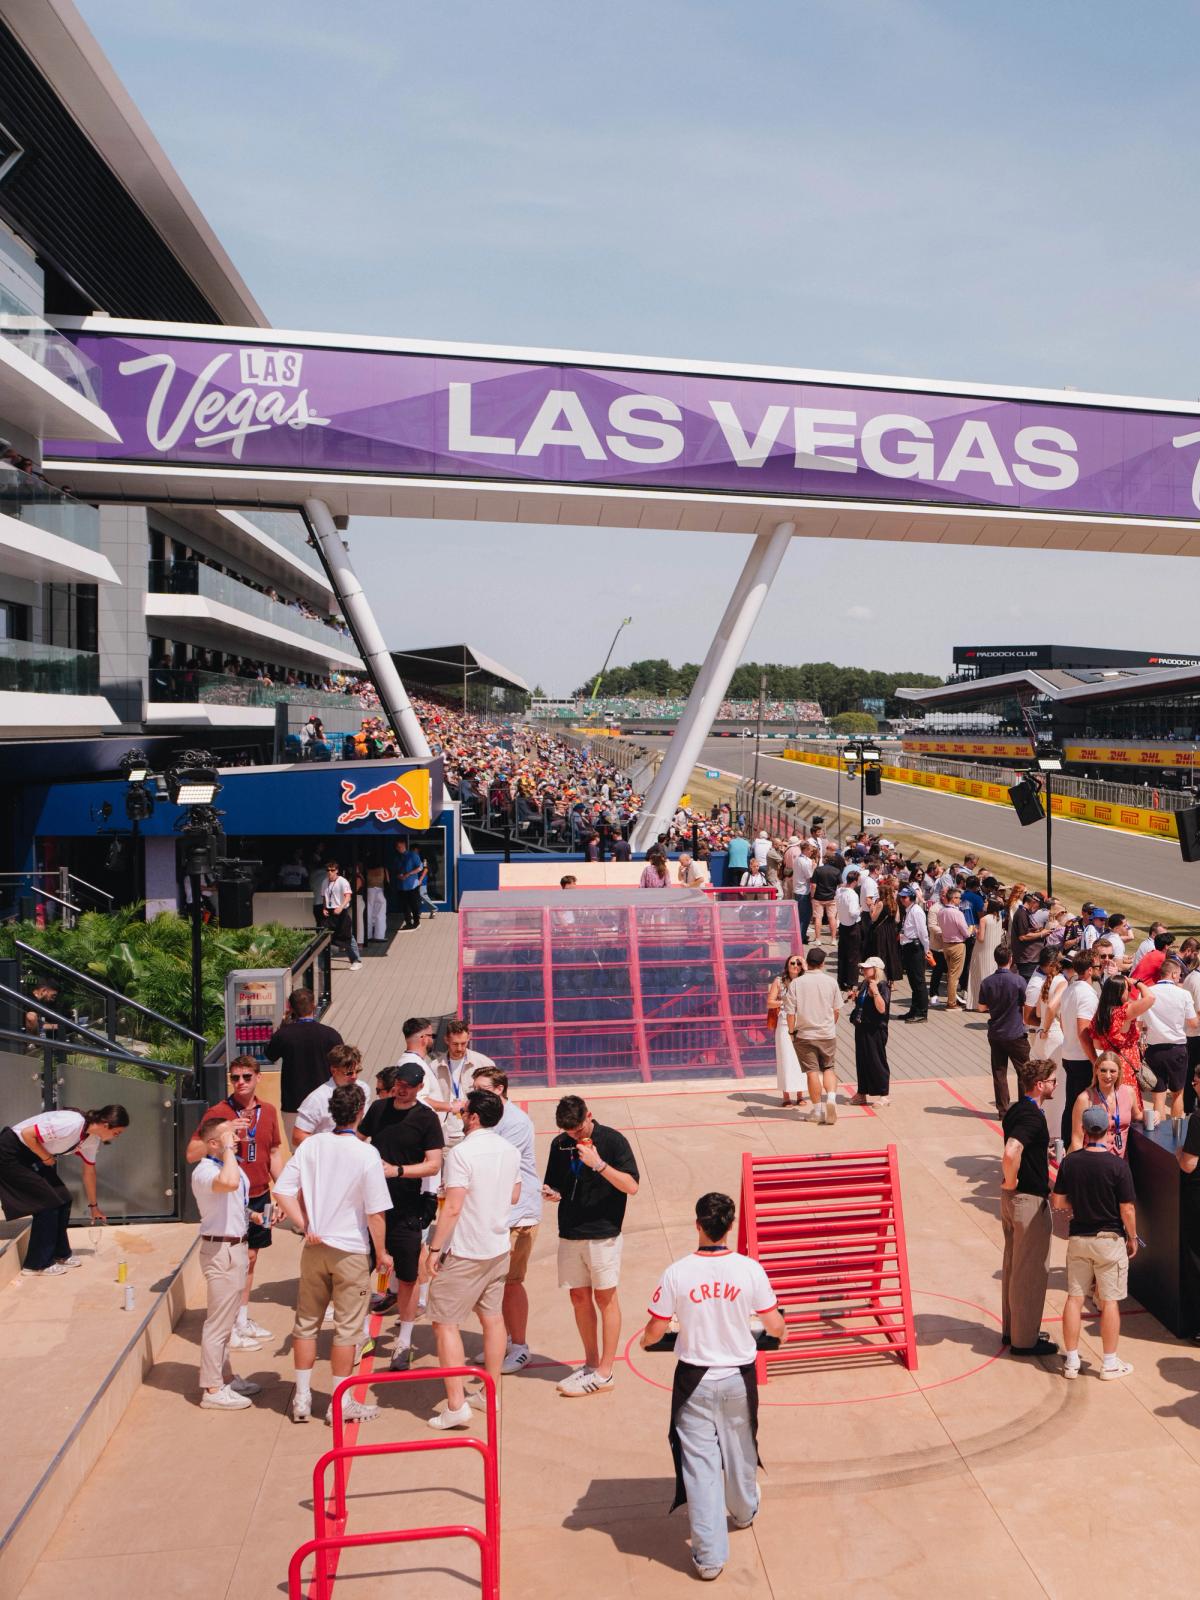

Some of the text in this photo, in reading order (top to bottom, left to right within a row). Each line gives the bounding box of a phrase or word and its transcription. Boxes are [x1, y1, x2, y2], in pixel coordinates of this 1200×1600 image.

[247, 353, 297, 382] LAS
[448, 382, 1080, 491] LAS VEGAS
[1158, 658, 1191, 666] PADDOCK
[1150, 816, 1169, 831] PIRELLI
[689, 1282, 741, 1303] CREW
